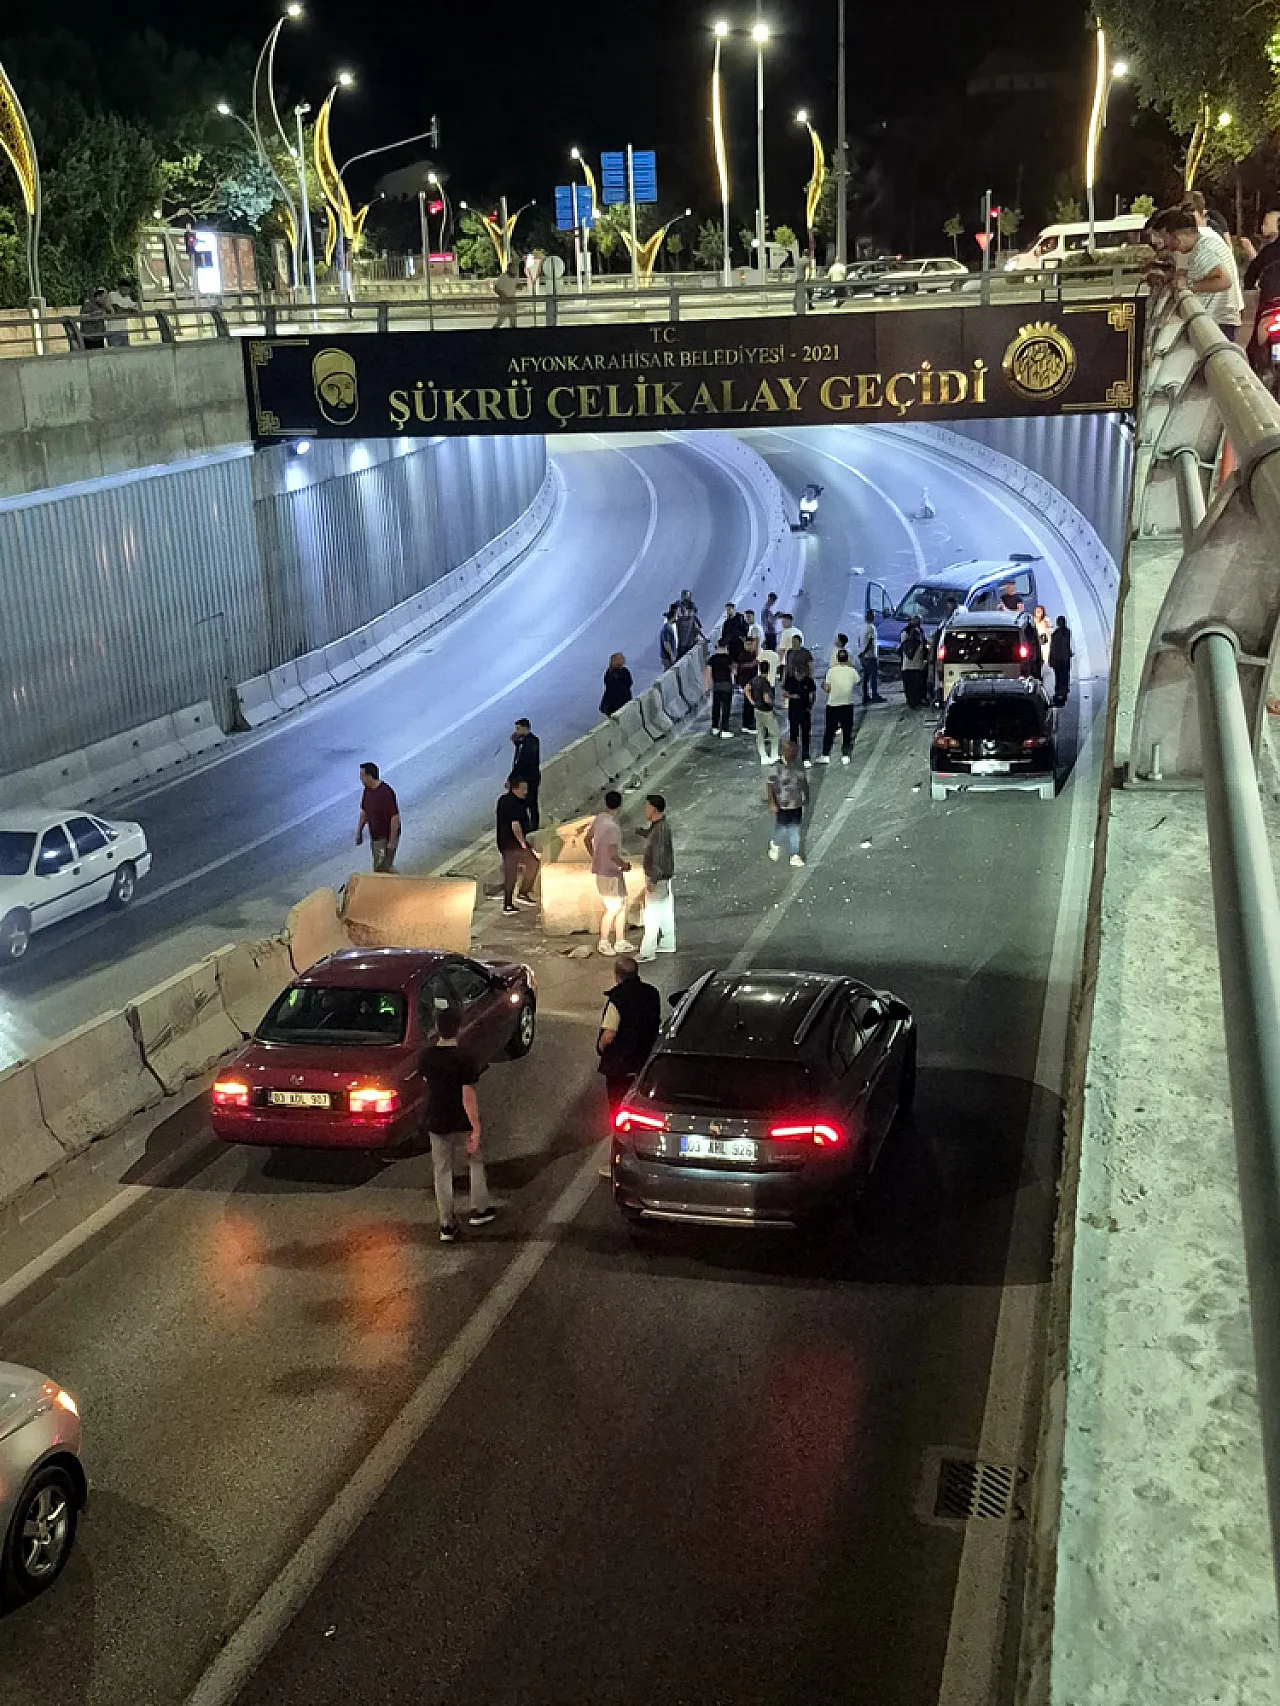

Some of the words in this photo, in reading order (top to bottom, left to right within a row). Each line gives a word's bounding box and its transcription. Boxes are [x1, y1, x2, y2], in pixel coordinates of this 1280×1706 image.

[508, 350, 675, 372] AFYONKARAHİSAR
[680, 344, 784, 368] BELEDİYESİ
[802, 344, 839, 363] 2021
[388, 379, 533, 430] ŞÜKRÜ
[820, 358, 988, 416] GEÇİDİ
